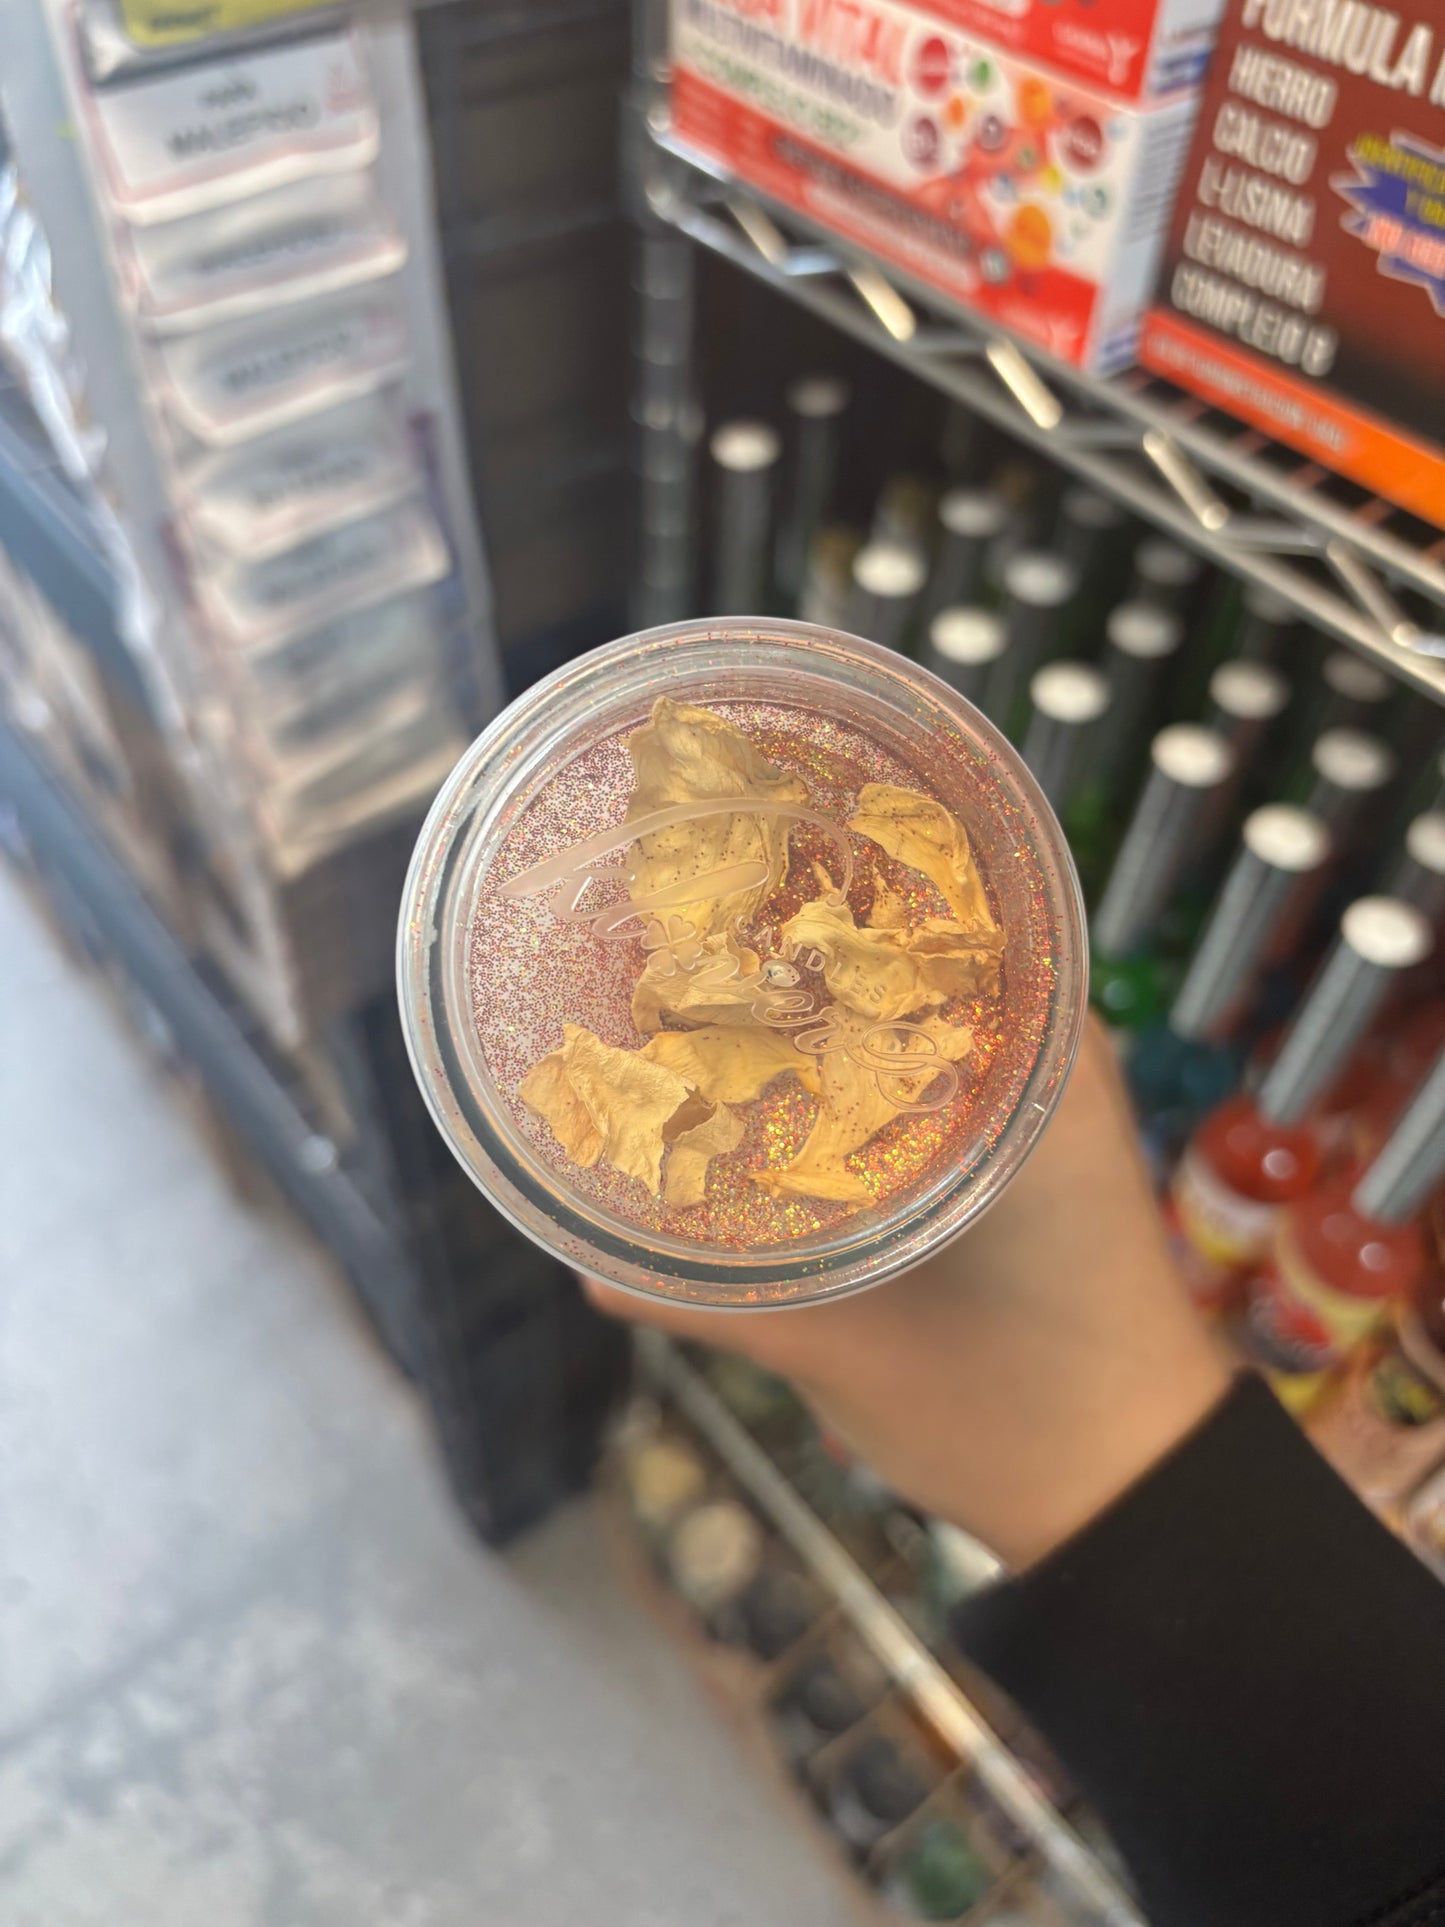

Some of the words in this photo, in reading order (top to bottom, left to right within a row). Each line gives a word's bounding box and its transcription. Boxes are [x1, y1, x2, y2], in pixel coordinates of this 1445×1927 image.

[1229, 43, 1338, 129] HIERRO
[1213, 102, 1319, 185] CALCIO
[1199, 153, 1316, 248] L-LISINA
[1184, 208, 1327, 315] LEVADURA
